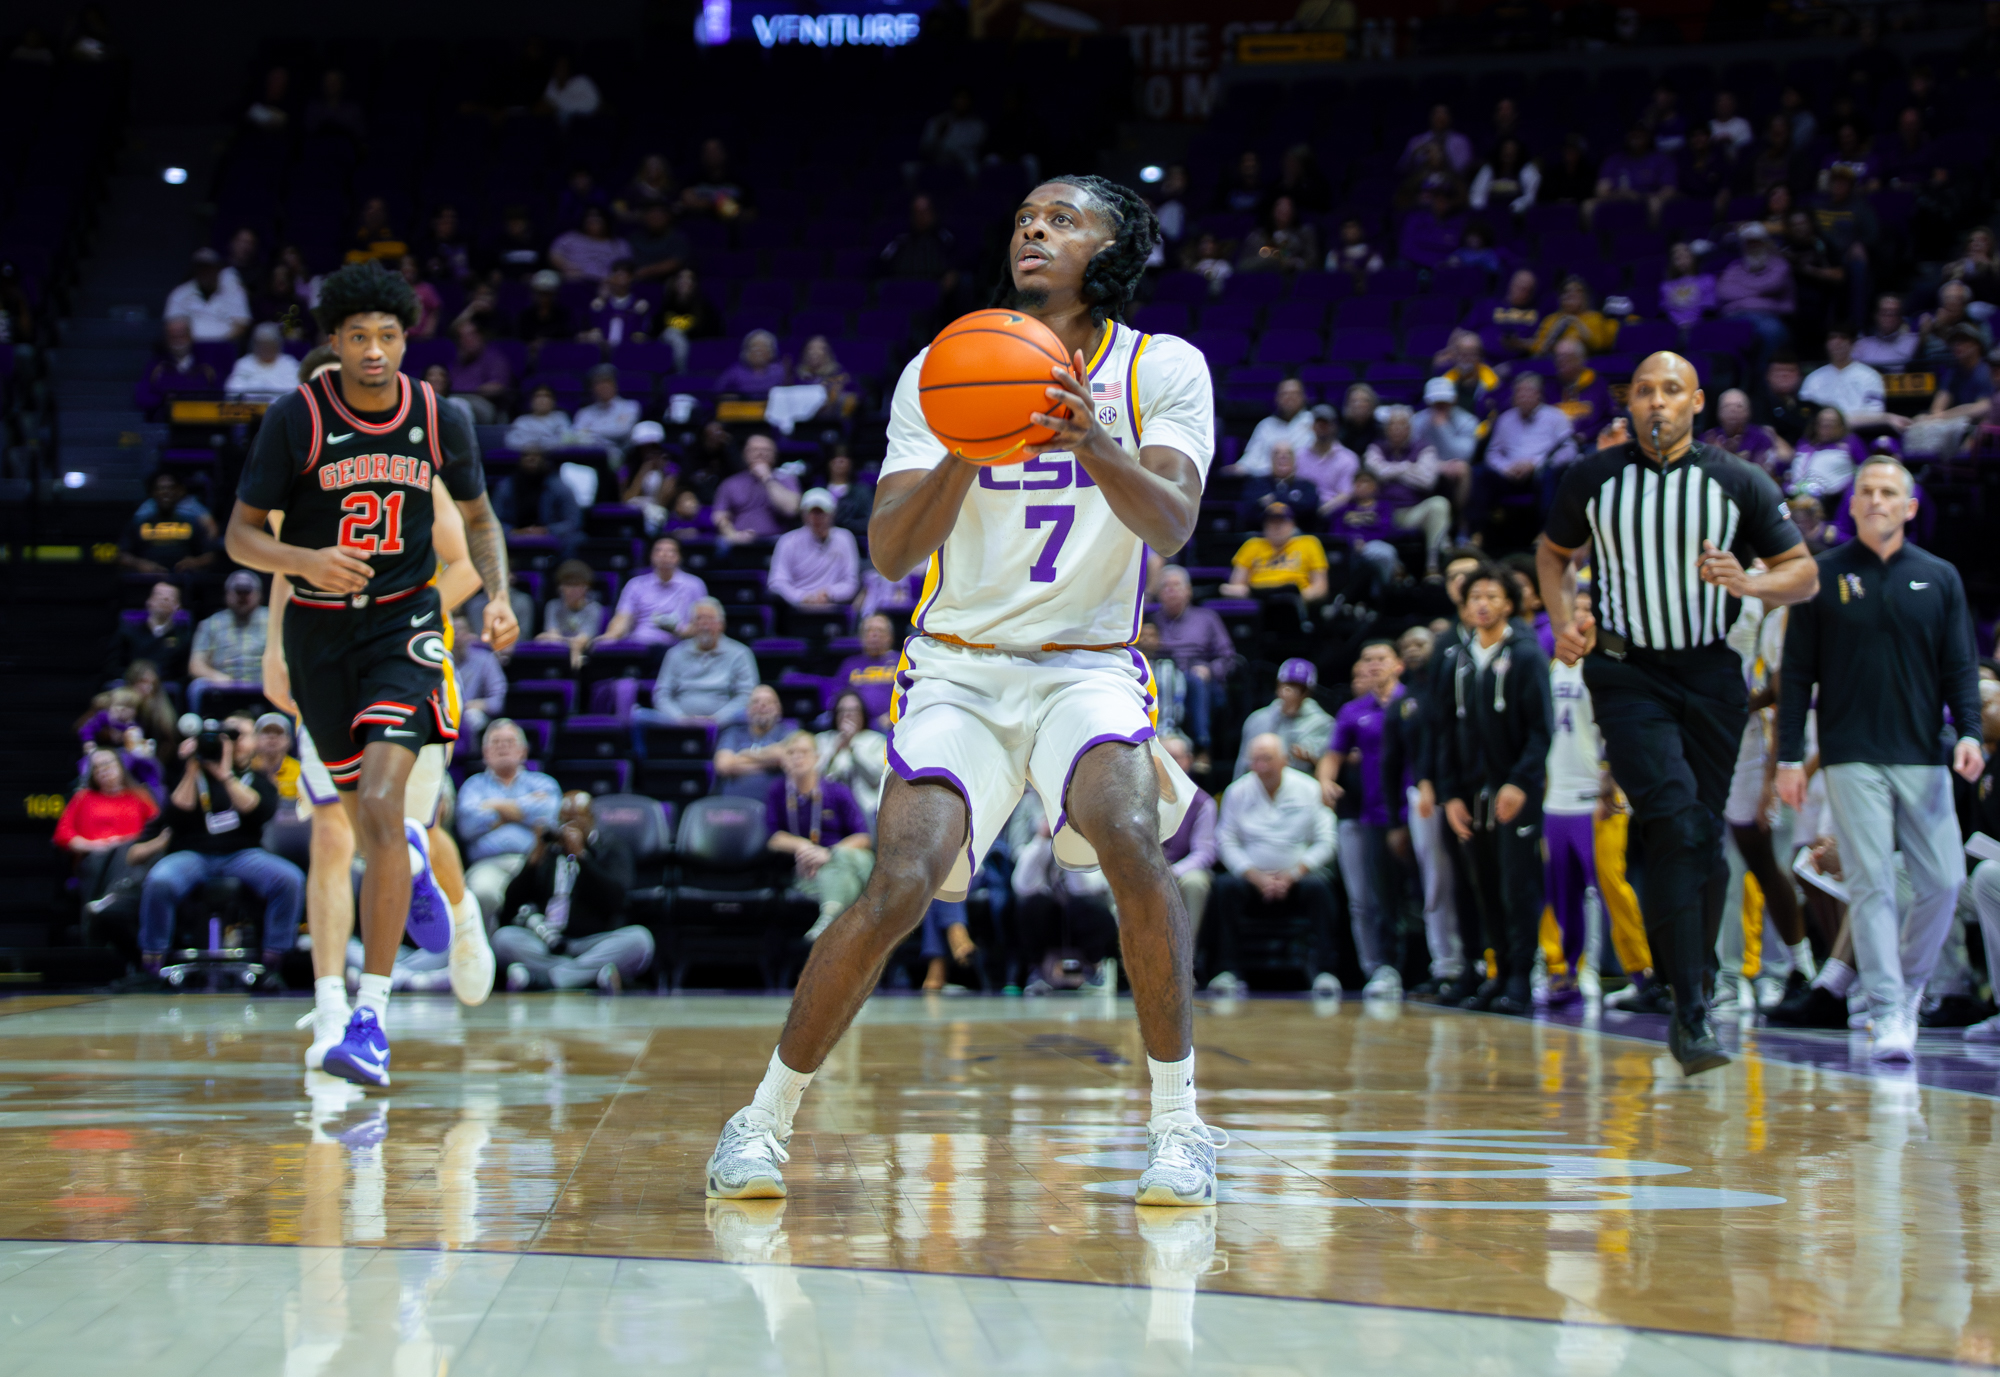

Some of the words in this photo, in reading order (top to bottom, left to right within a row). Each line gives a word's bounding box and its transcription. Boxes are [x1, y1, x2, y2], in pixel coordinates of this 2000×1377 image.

[751, 13, 920, 47] VENTURE
[1100, 407, 1116, 425] SEC
[319, 454, 432, 492] GEORGIA
[337, 491, 405, 554] 21
[1025, 505, 1075, 583] 7
